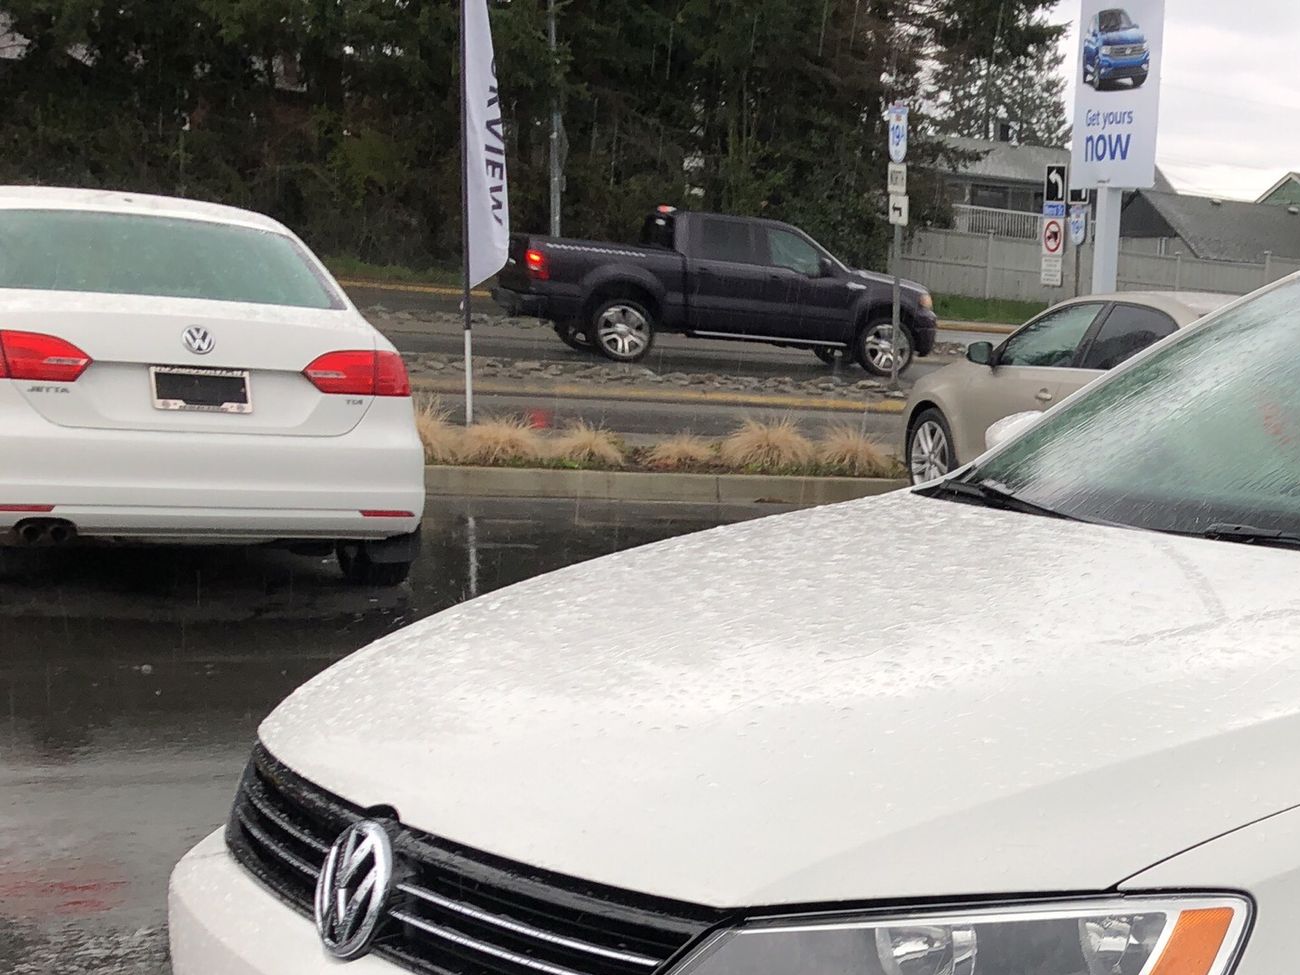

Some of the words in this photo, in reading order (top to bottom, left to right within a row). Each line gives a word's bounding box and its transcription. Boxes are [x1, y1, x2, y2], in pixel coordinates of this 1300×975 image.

[1086, 108, 1101, 127] Get
[1103, 110, 1134, 130] yours
[1085, 133, 1132, 162] now
